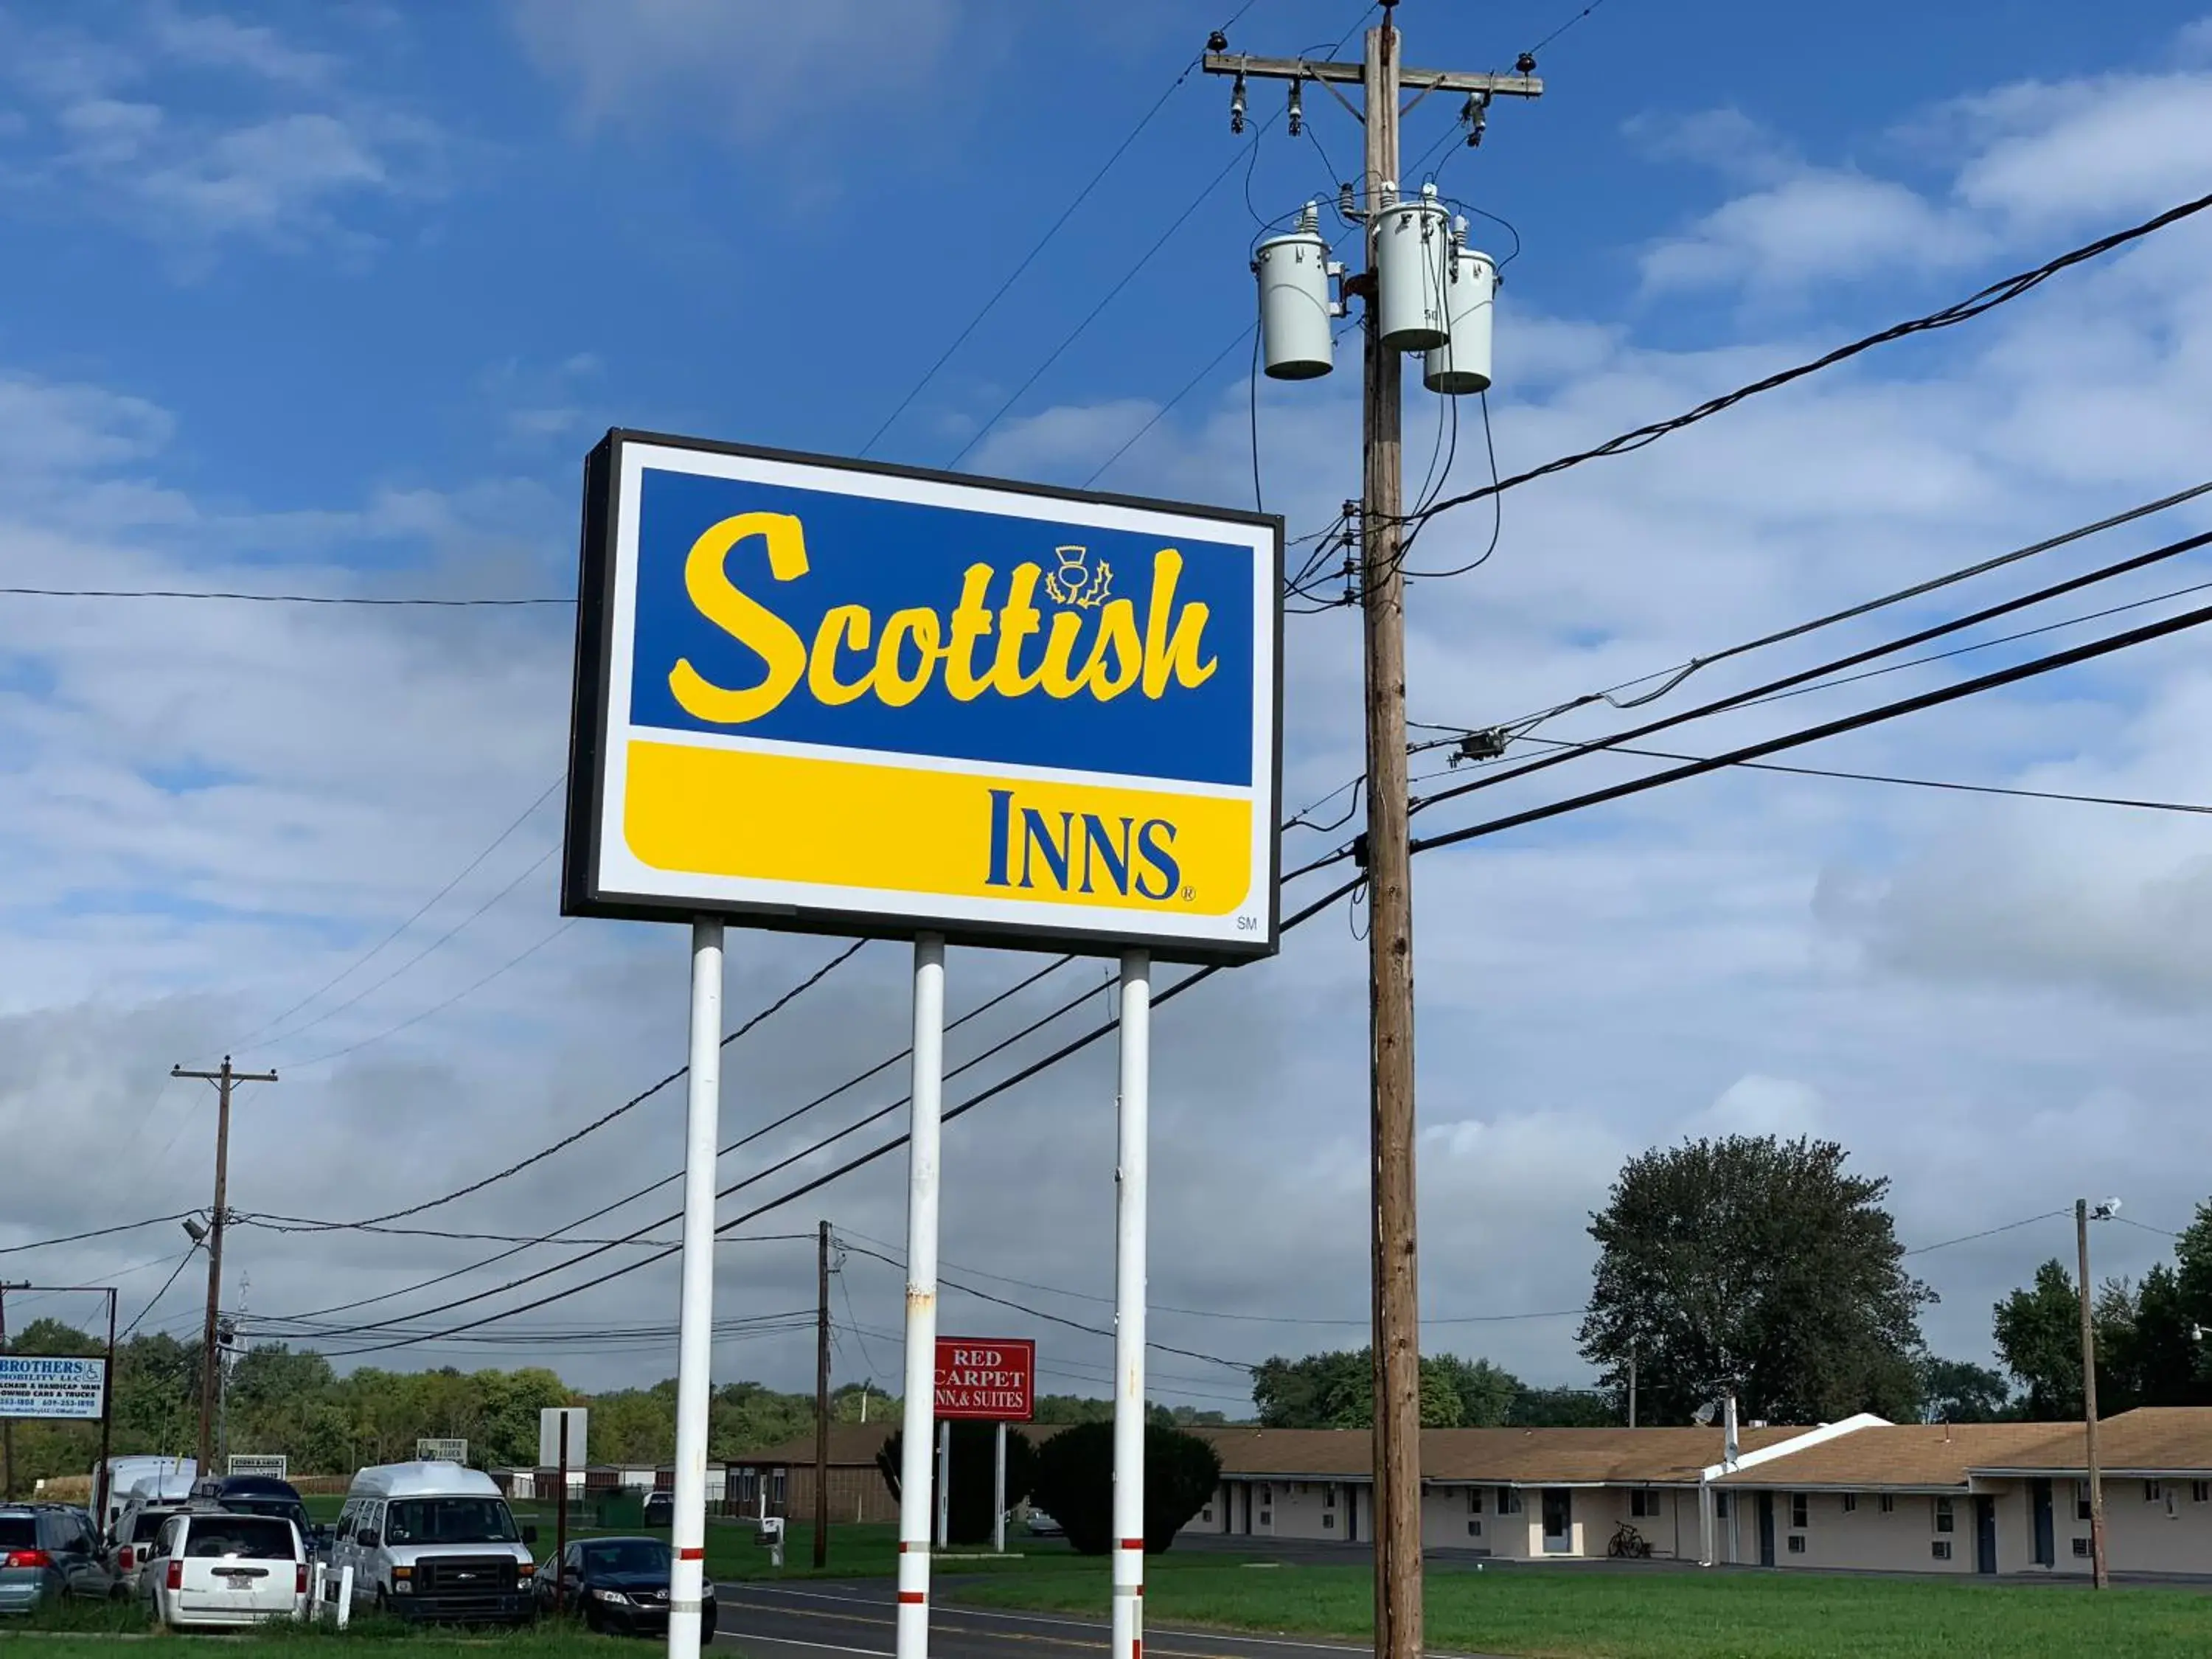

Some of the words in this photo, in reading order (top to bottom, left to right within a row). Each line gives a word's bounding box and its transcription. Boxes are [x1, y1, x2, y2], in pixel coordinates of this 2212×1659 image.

[669, 512, 1217, 723] Scottish
[985, 789, 1180, 900] INNS
[1237, 917, 1257, 931] SM
[953, 1349, 1002, 1366] RED
[0, 1360, 83, 1373] BROTHERS
[933, 1369, 1025, 1388] CARPET
[959, 1391, 970, 1406] &
[973, 1391, 1023, 1408] SUITES
